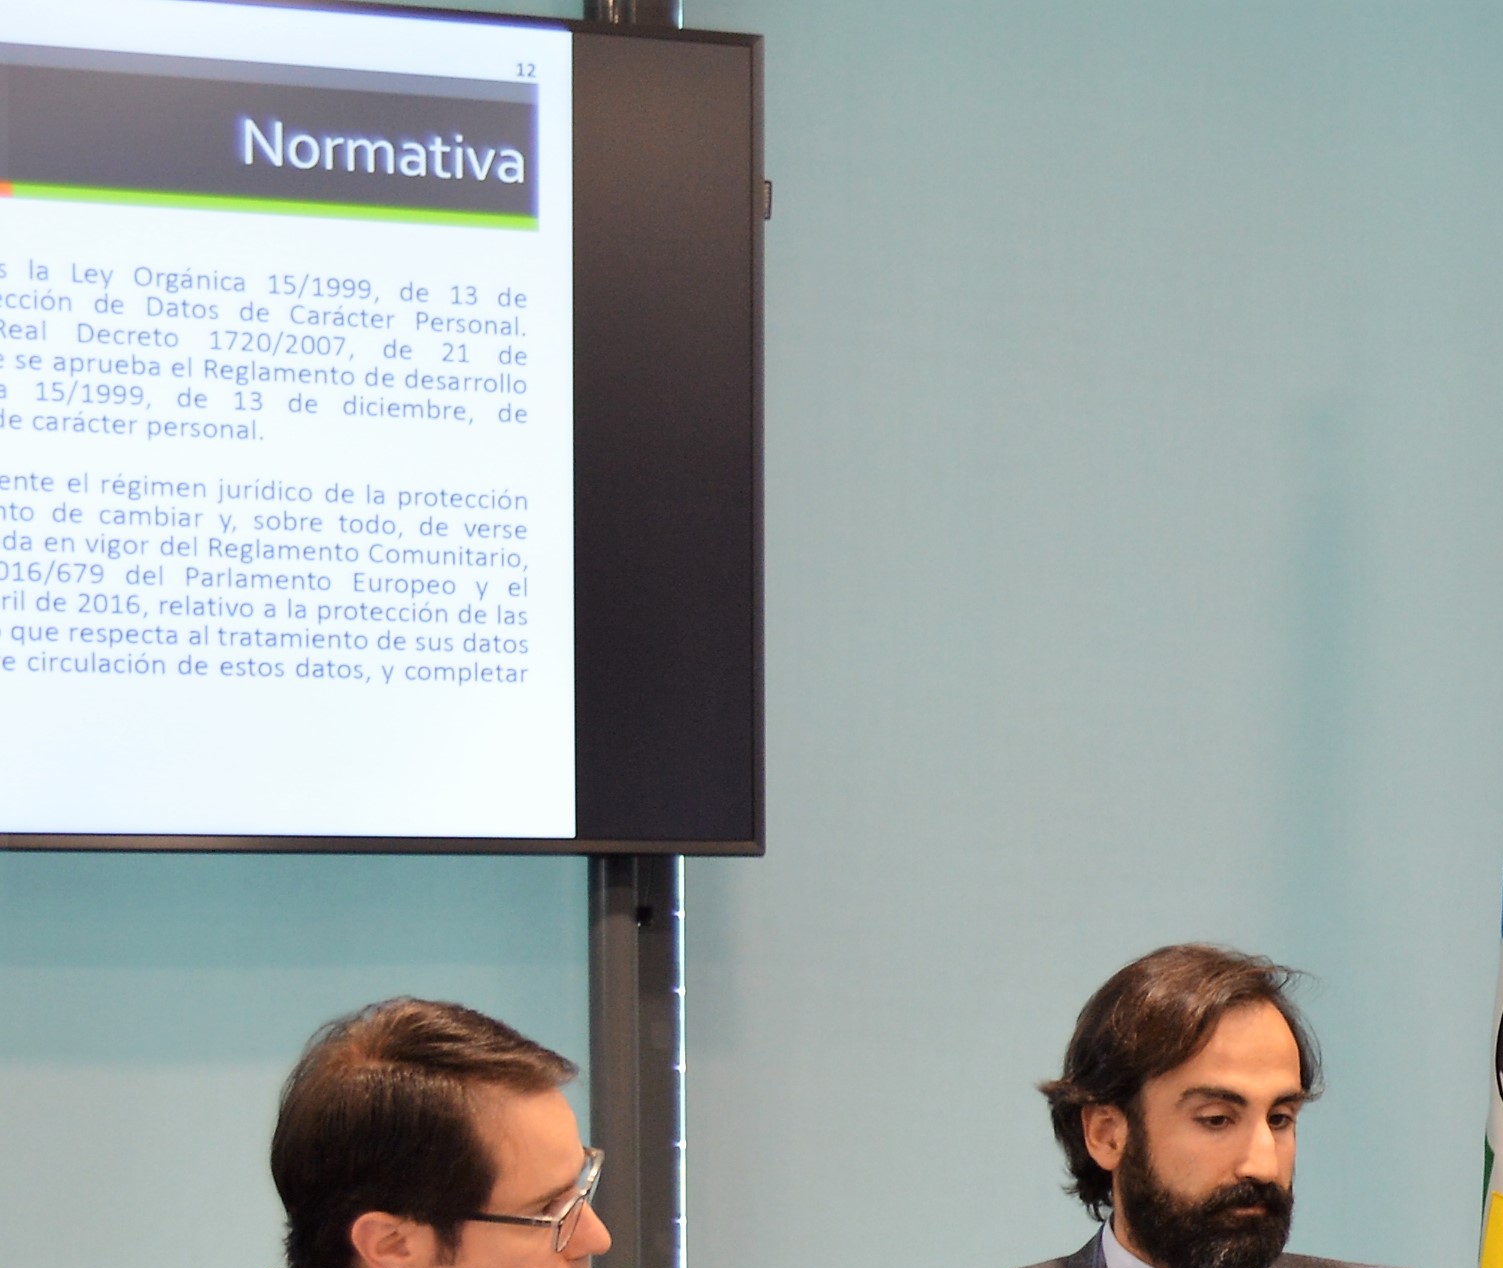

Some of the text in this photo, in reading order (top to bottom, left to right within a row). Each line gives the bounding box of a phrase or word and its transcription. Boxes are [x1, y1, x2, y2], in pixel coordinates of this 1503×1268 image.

[515, 63, 537, 78] 12
[243, 117, 526, 184] Normativa
[28, 257, 50, 282] la
[71, 262, 115, 292] Ley
[132, 265, 247, 295] Orgánica
[267, 272, 380, 305] 15/1999,
[399, 280, 430, 304] de
[450, 284, 479, 307] 13
[496, 286, 528, 310] de
[93, 291, 125, 316] de
[145, 295, 220, 321] Datos
[238, 300, 271, 324] de
[288, 303, 396, 330] Carácter
[415, 310, 527, 337] Personal.
[76, 321, 180, 349] Decreto
[209, 329, 355, 362] 1720/2007,
[382, 337, 414, 362] de
[441, 341, 471, 364] 21
[497, 344, 528, 367] de
[14, 353, 44, 372] se
[52, 352, 162, 379] aprueba
[169, 355, 193, 379] el
[203, 357, 356, 387] Reglamento
[363, 365, 396, 389] de
[403, 367, 528, 396] desarrollo
[35, 379, 152, 411] 15/1999,
[175, 386, 209, 410] de
[233, 389, 264, 412] 13
[287, 391, 319, 415] de
[342, 393, 475, 426] diciembre,
[497, 401, 529, 425] de
[31, 410, 139, 436] carácter
[146, 418, 264, 441] personal.
[0, 471, 529, 512] ente el régimen jurídico de la protección
[51, 501, 84, 525] de
[98, 504, 205, 529] cambiar
[217, 512, 238, 535] y,
[253, 509, 324, 534] sobre
[337, 512, 404, 540] todo,
[418, 514, 450, 538] de
[463, 521, 529, 541] verse
[43, 535, 76, 554] en
[84, 532, 150, 561] vigor
[159, 534, 199, 558] del
[207, 536, 361, 566] Reglamento
[367, 542, 529, 573] Comunitario,
[124, 563, 164, 587] del
[184, 565, 333, 593] Parlamento
[351, 570, 457, 600] Europeo
[474, 580, 489, 603] y
[507, 576, 528, 599] el
[1, 589, 529, 627] ril de 2016, relativo a la protección de las
[9, 624, 60, 647] que
[68, 624, 179, 649] respecta
[187, 623, 210, 647] al
[216, 626, 370, 651] tratamiento
[375, 628, 408, 652] de
[415, 635, 455, 654] sus
[462, 631, 529, 656] datos
[26, 650, 167, 676] circulación
[177, 653, 210, 677] de
[218, 657, 286, 679] estos
[294, 656, 372, 684] datos,
[380, 663, 395, 686] y
[403, 660, 529, 687] completar
